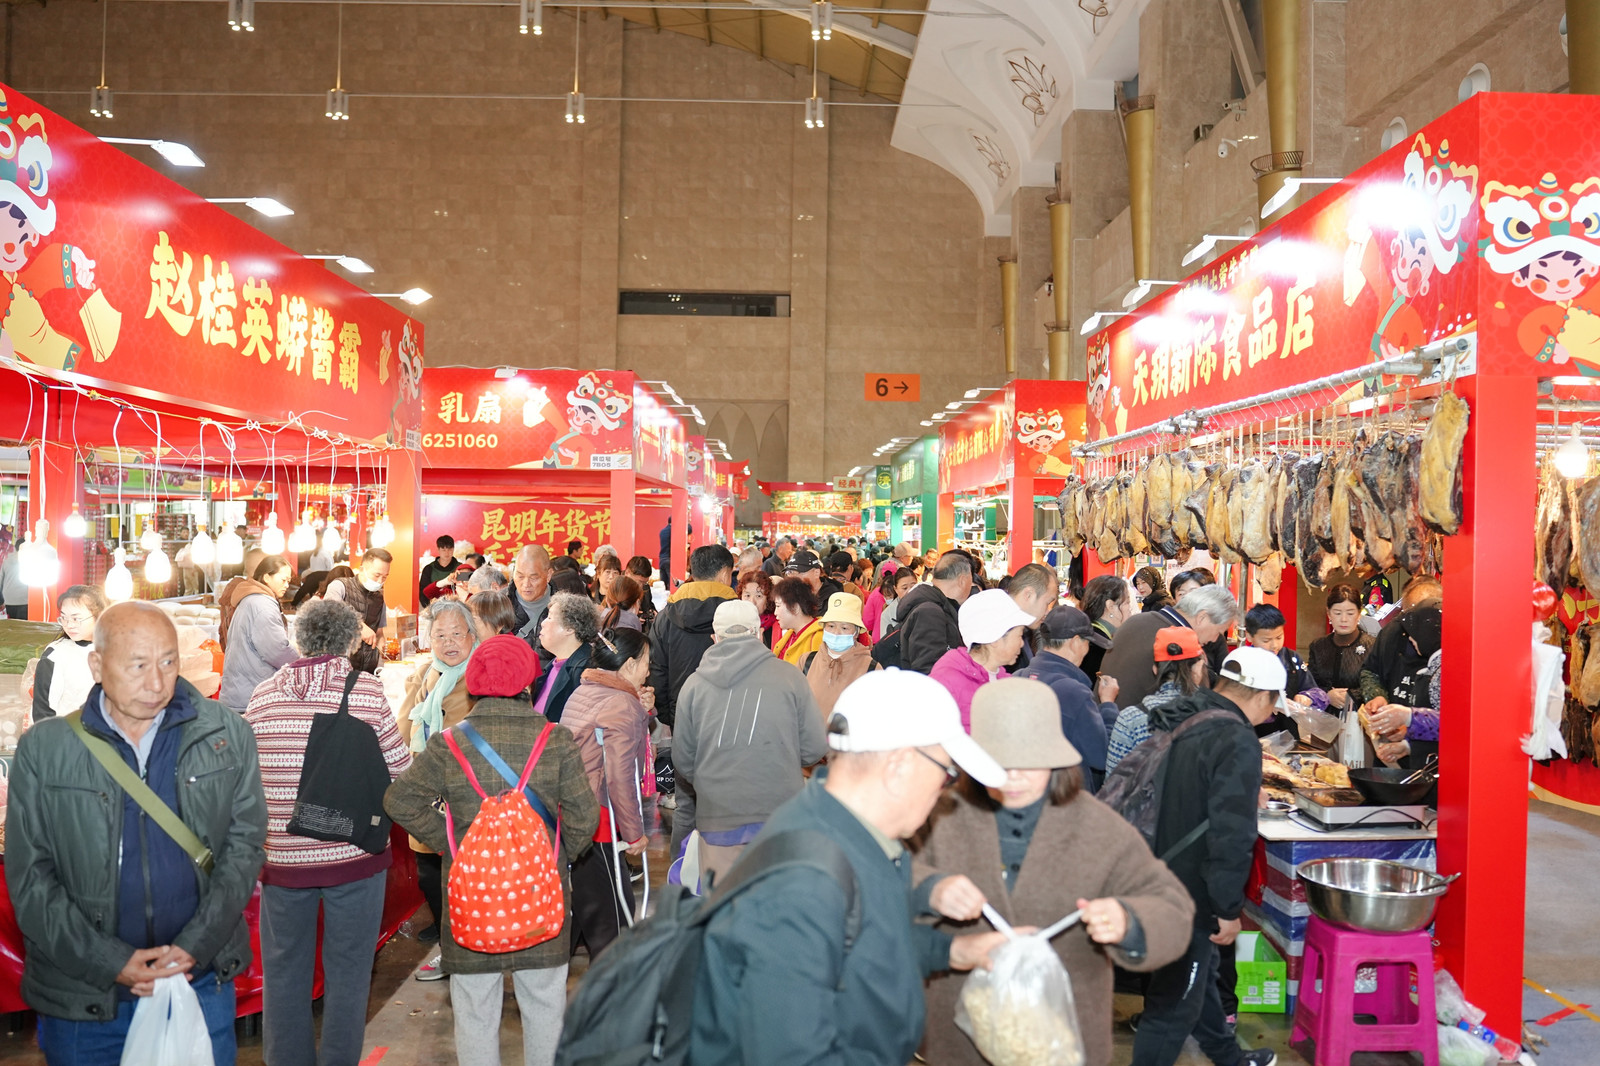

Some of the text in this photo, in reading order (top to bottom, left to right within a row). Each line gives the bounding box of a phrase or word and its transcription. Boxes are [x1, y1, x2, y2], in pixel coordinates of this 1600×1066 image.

[875, 377, 889, 397] 6
[437, 390, 502, 425] 乳扇
[422, 433, 498, 448] 6251060
[480, 507, 612, 545] 昆明年货节
